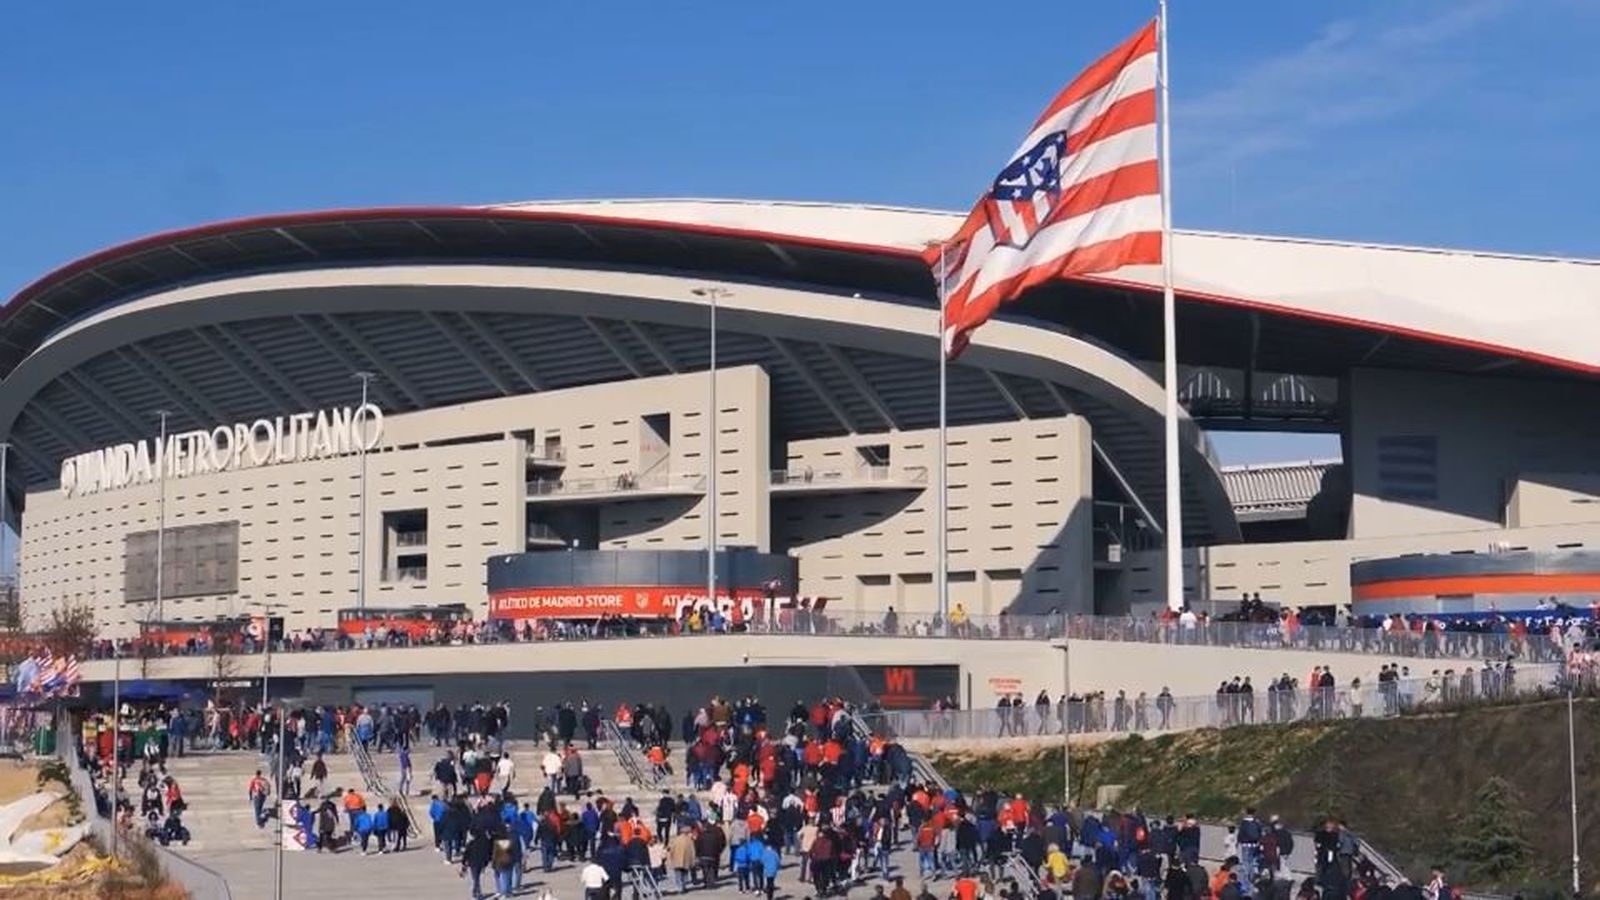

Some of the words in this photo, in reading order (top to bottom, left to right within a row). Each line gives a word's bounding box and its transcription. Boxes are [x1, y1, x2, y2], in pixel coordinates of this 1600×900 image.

[76, 439, 153, 494] WANDA
[155, 402, 384, 480] METROPOLITANO
[529, 597, 541, 609] DE
[542, 594, 584, 609] MADRID
[585, 593, 623, 608] STORE
